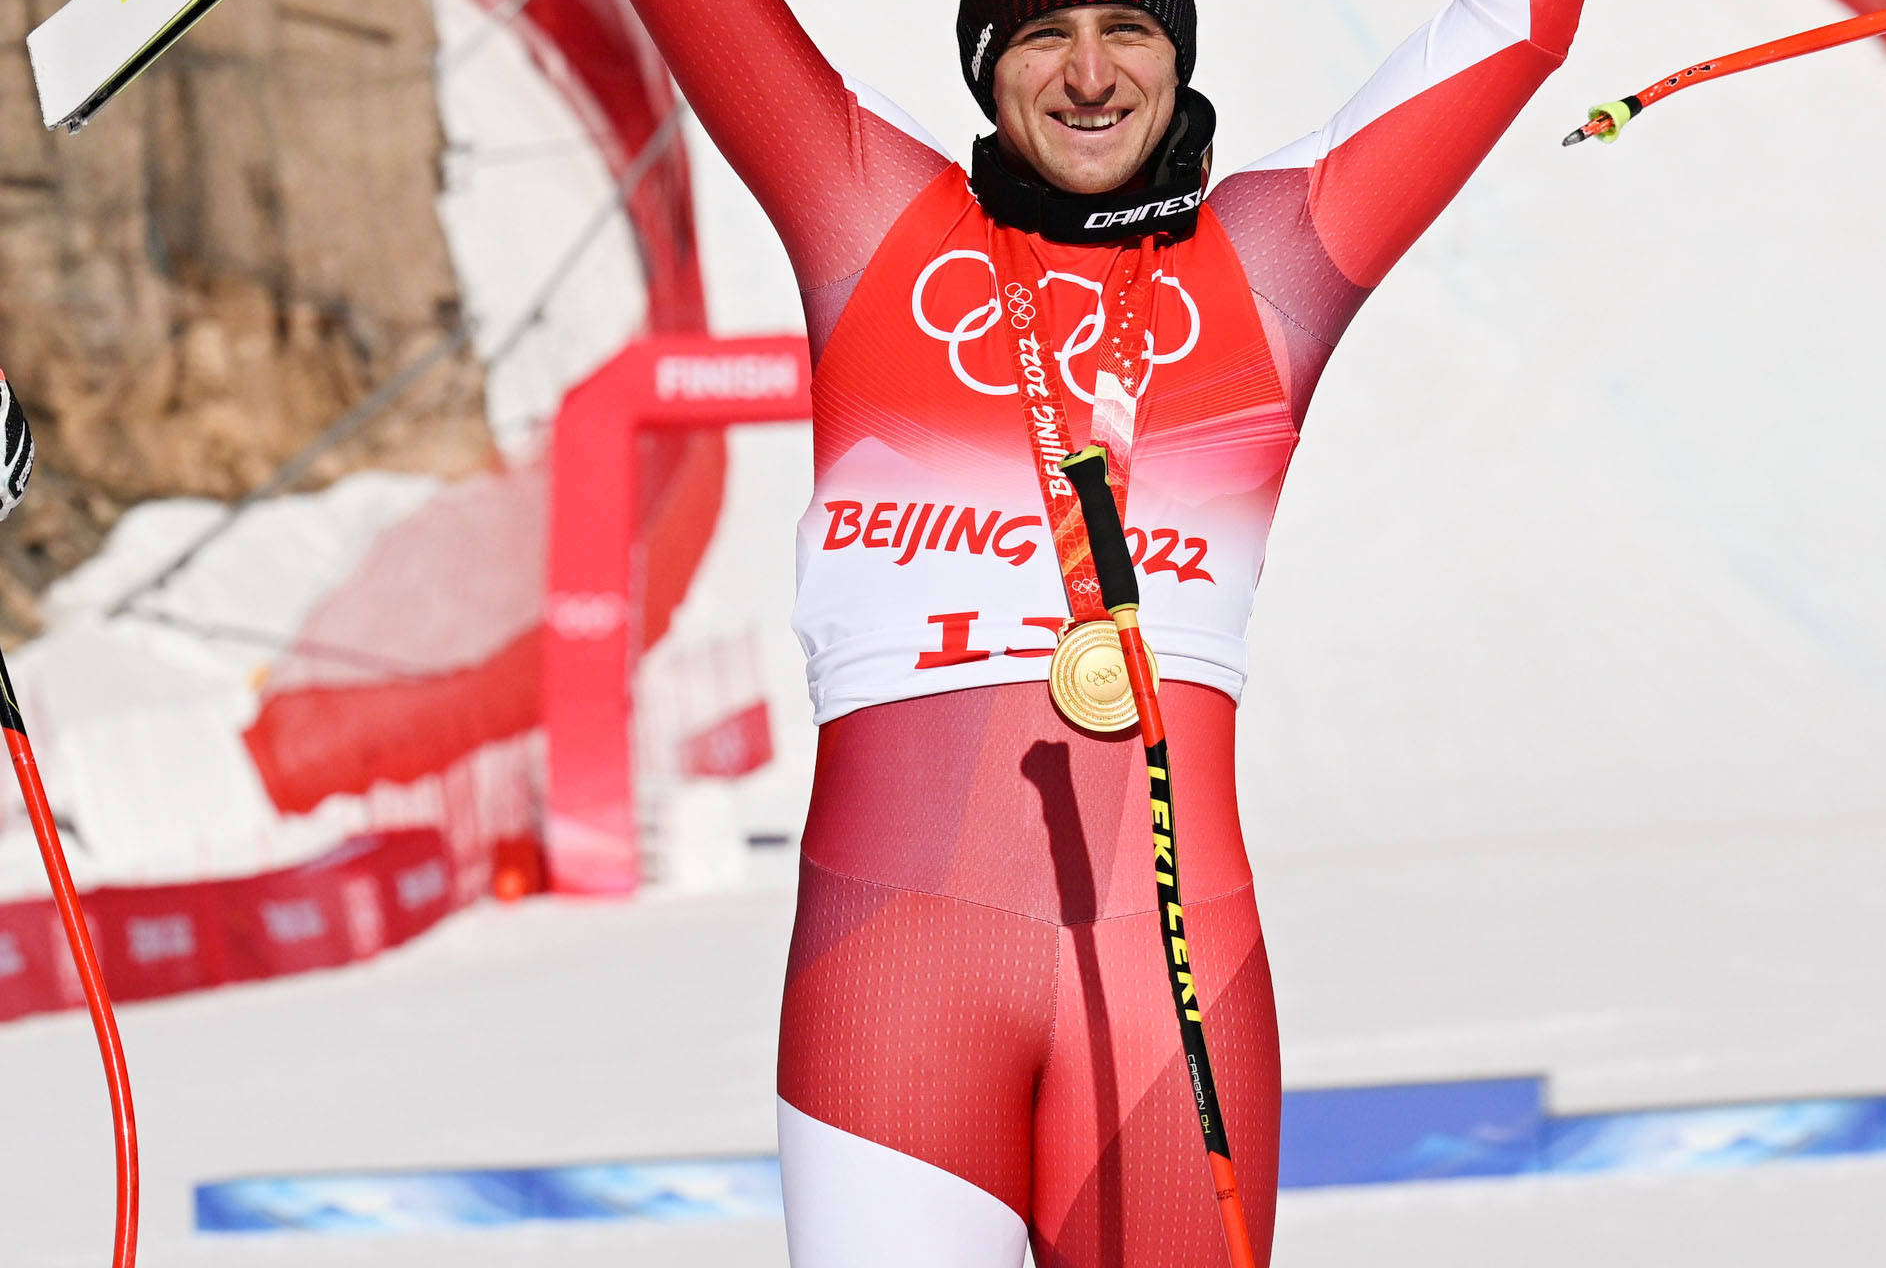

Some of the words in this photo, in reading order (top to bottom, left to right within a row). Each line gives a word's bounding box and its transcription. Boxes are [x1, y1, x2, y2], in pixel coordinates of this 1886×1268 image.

[656, 352, 799, 401] FINISH
[1018, 330, 1050, 398] 2022
[823, 499, 1043, 567] BEIJING
[1122, 527, 1217, 586] 022
[1147, 765, 1174, 888] LEKI
[1166, 901, 1203, 1023] LEKI
[1187, 1054, 1206, 1110] CARBON
